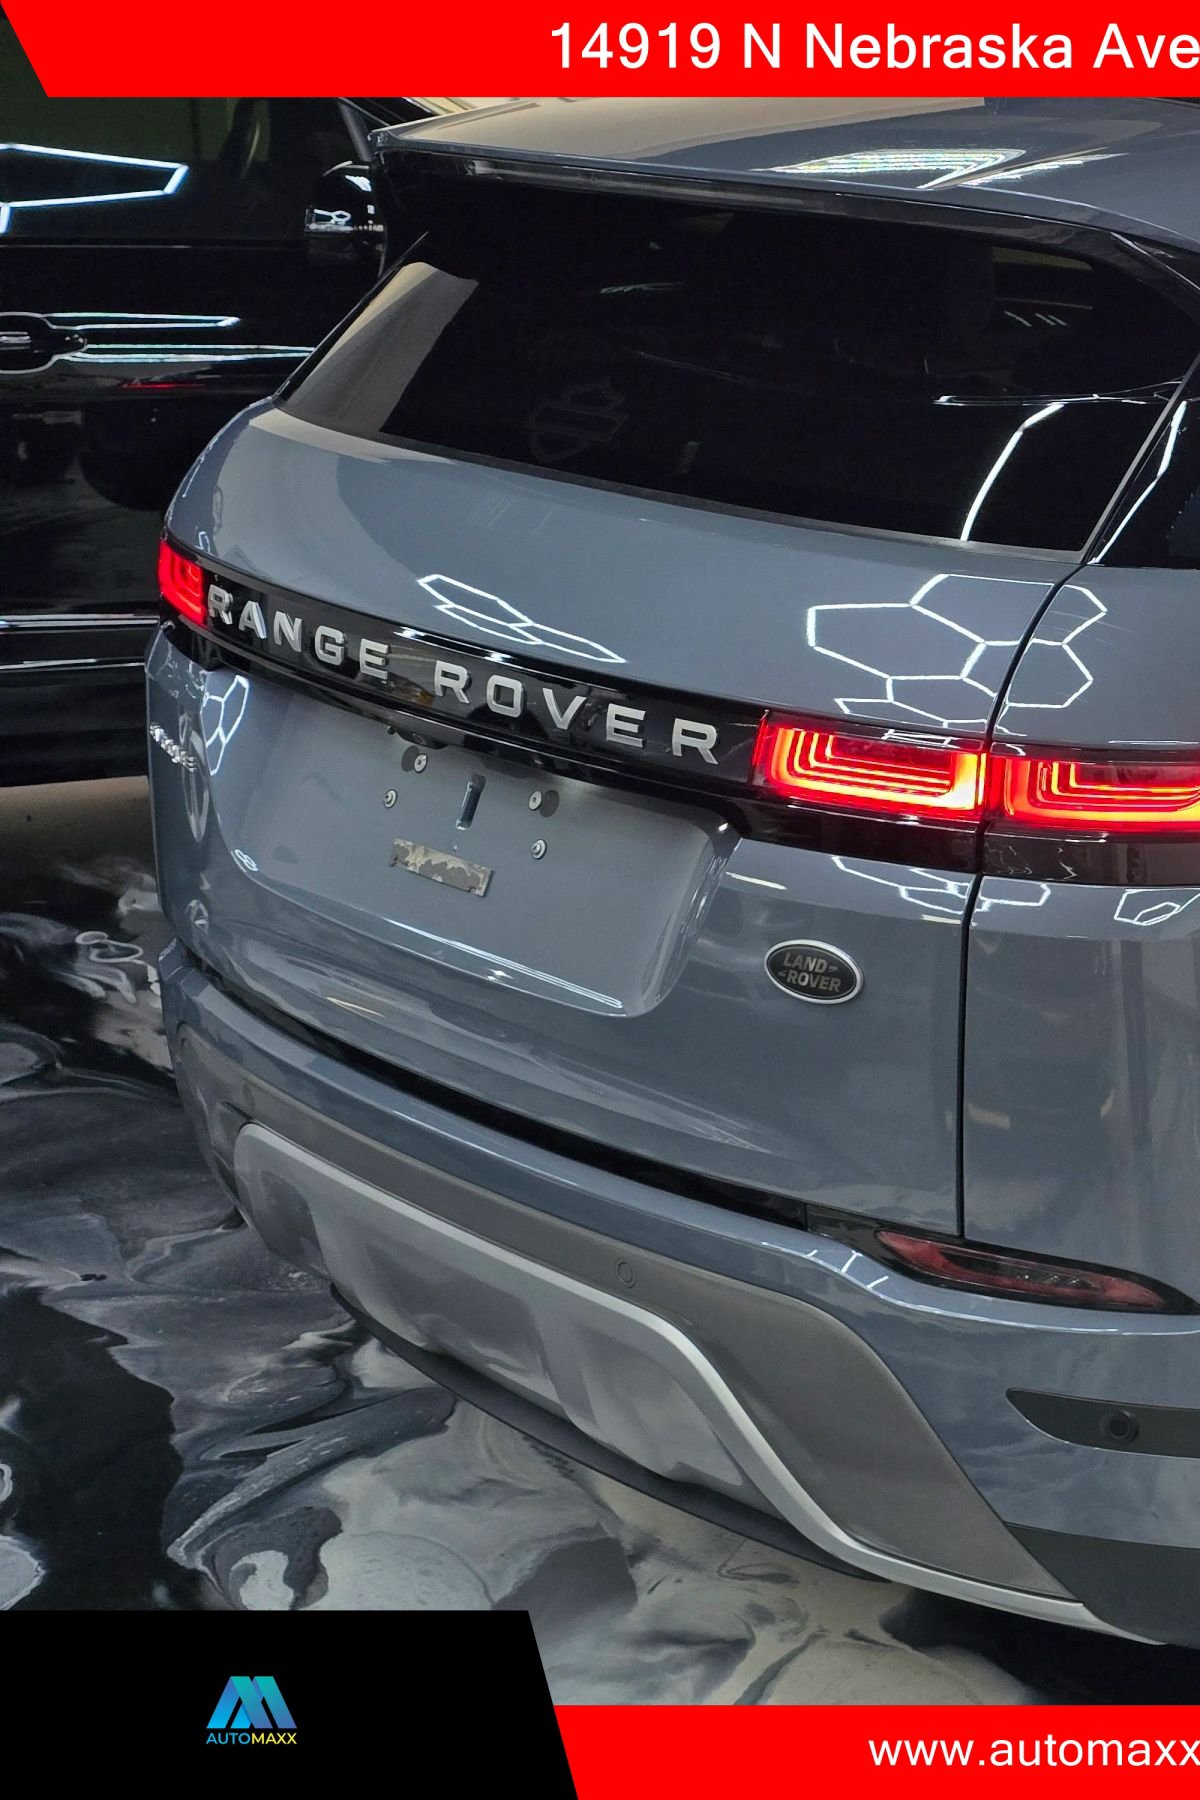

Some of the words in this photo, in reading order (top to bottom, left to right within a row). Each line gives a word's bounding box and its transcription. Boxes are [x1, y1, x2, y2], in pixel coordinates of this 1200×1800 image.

[207, 583, 389, 680] RANGE
[433, 660, 718, 766] ROVER
[782, 952, 828, 974] LAND
[786, 968, 842, 993] ROVER
